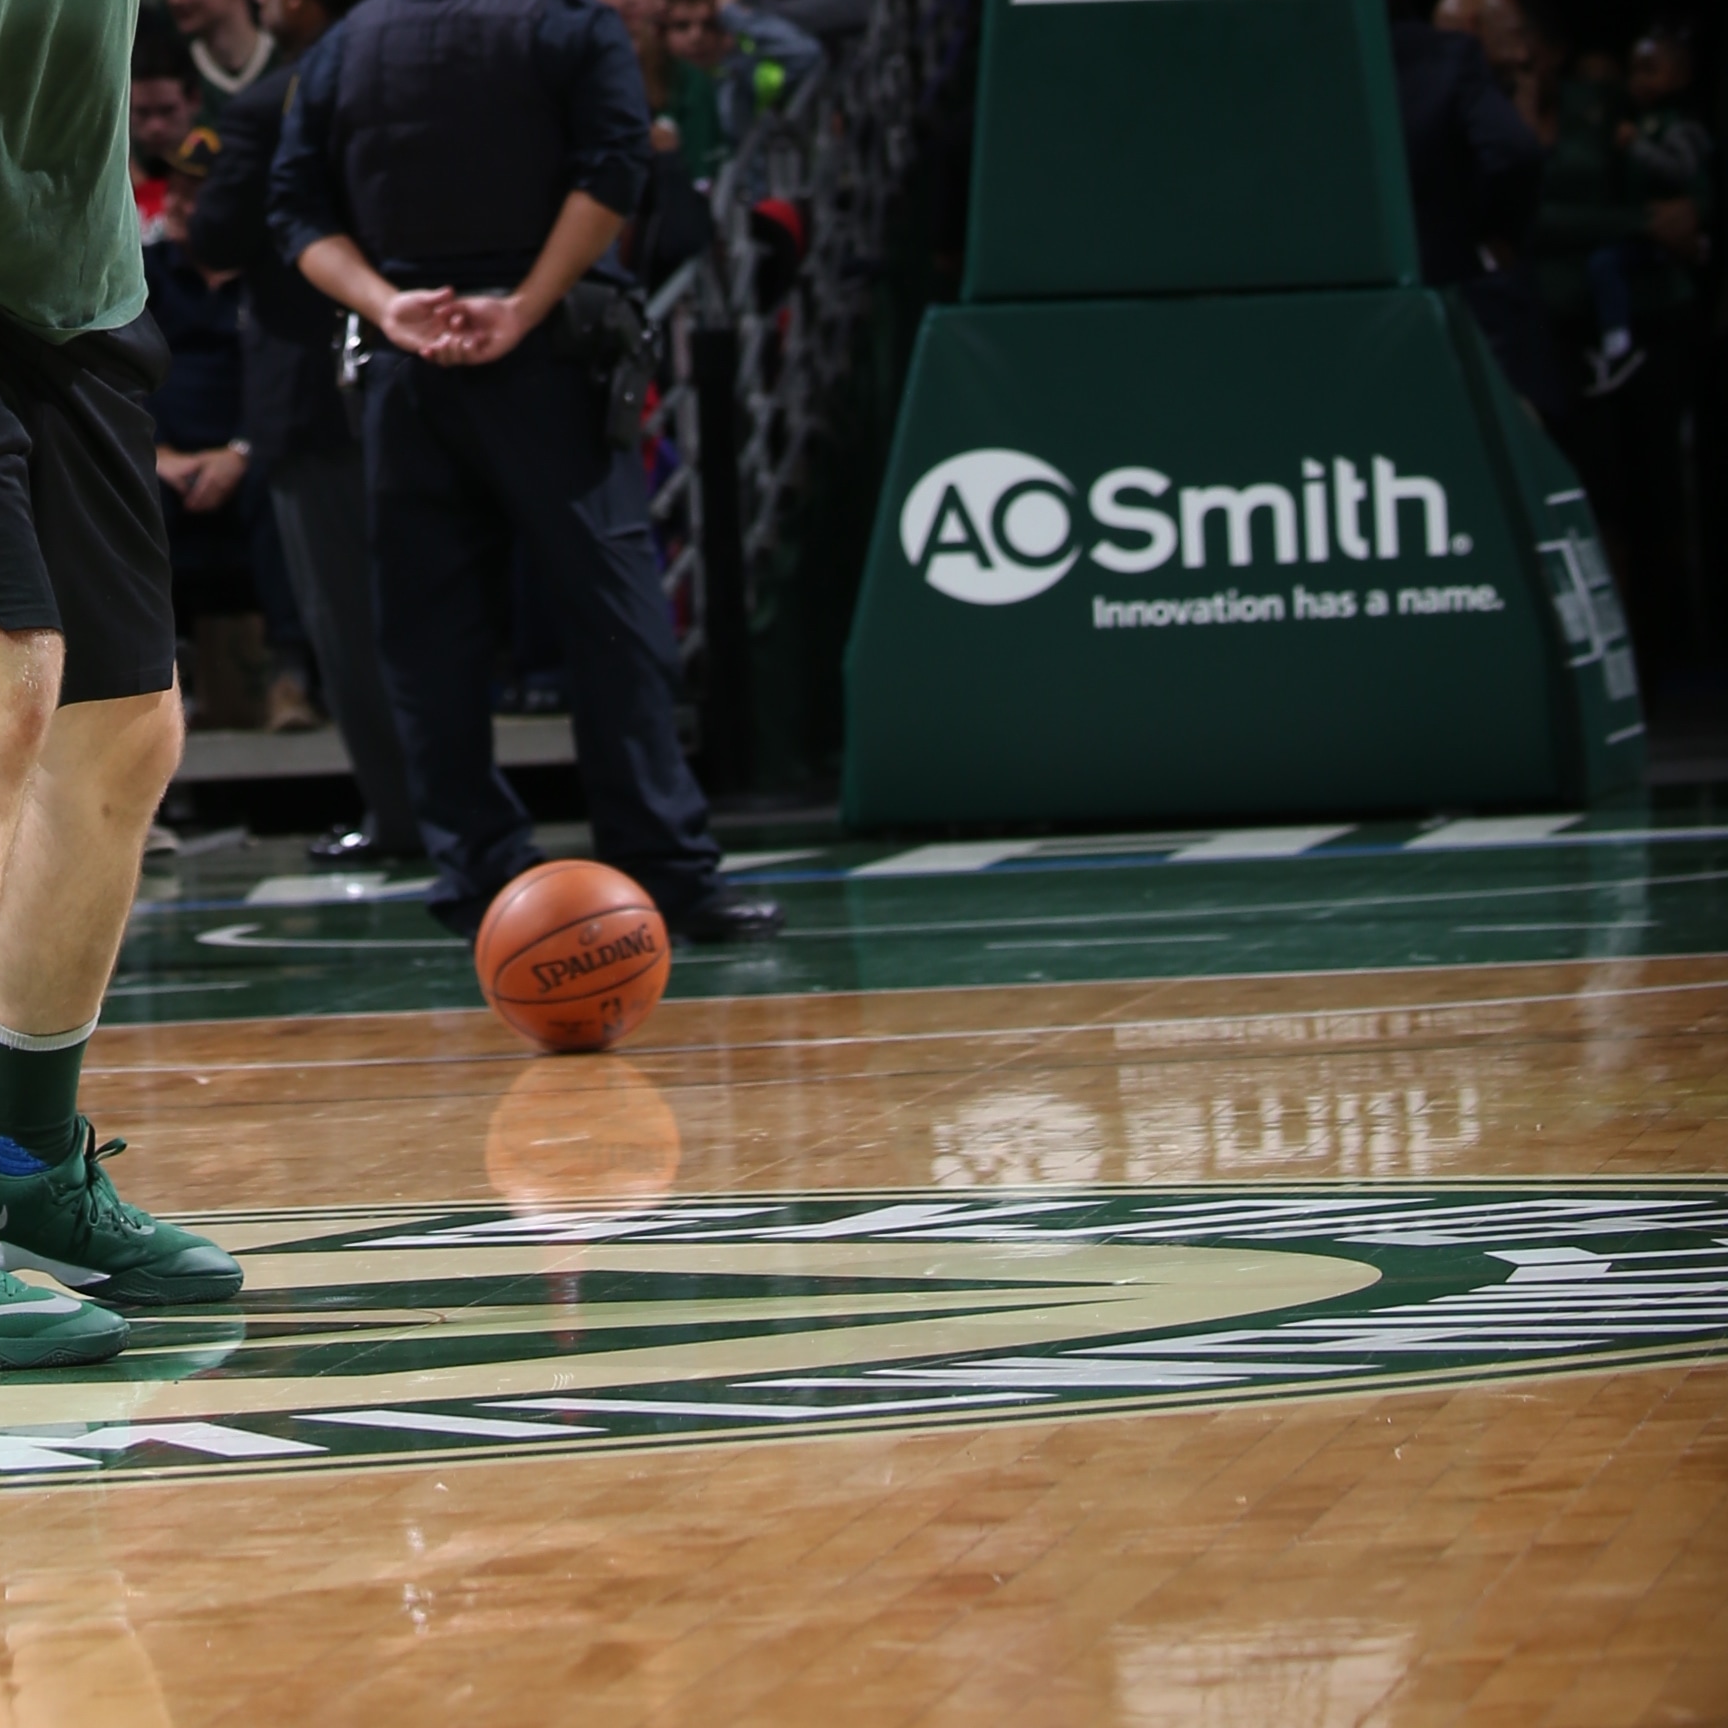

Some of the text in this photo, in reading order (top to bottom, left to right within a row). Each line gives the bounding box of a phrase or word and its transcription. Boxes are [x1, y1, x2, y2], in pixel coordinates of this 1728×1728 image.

[1092, 582, 1504, 630] Innovation has a name.
[531, 923, 656, 994] SPALDING
